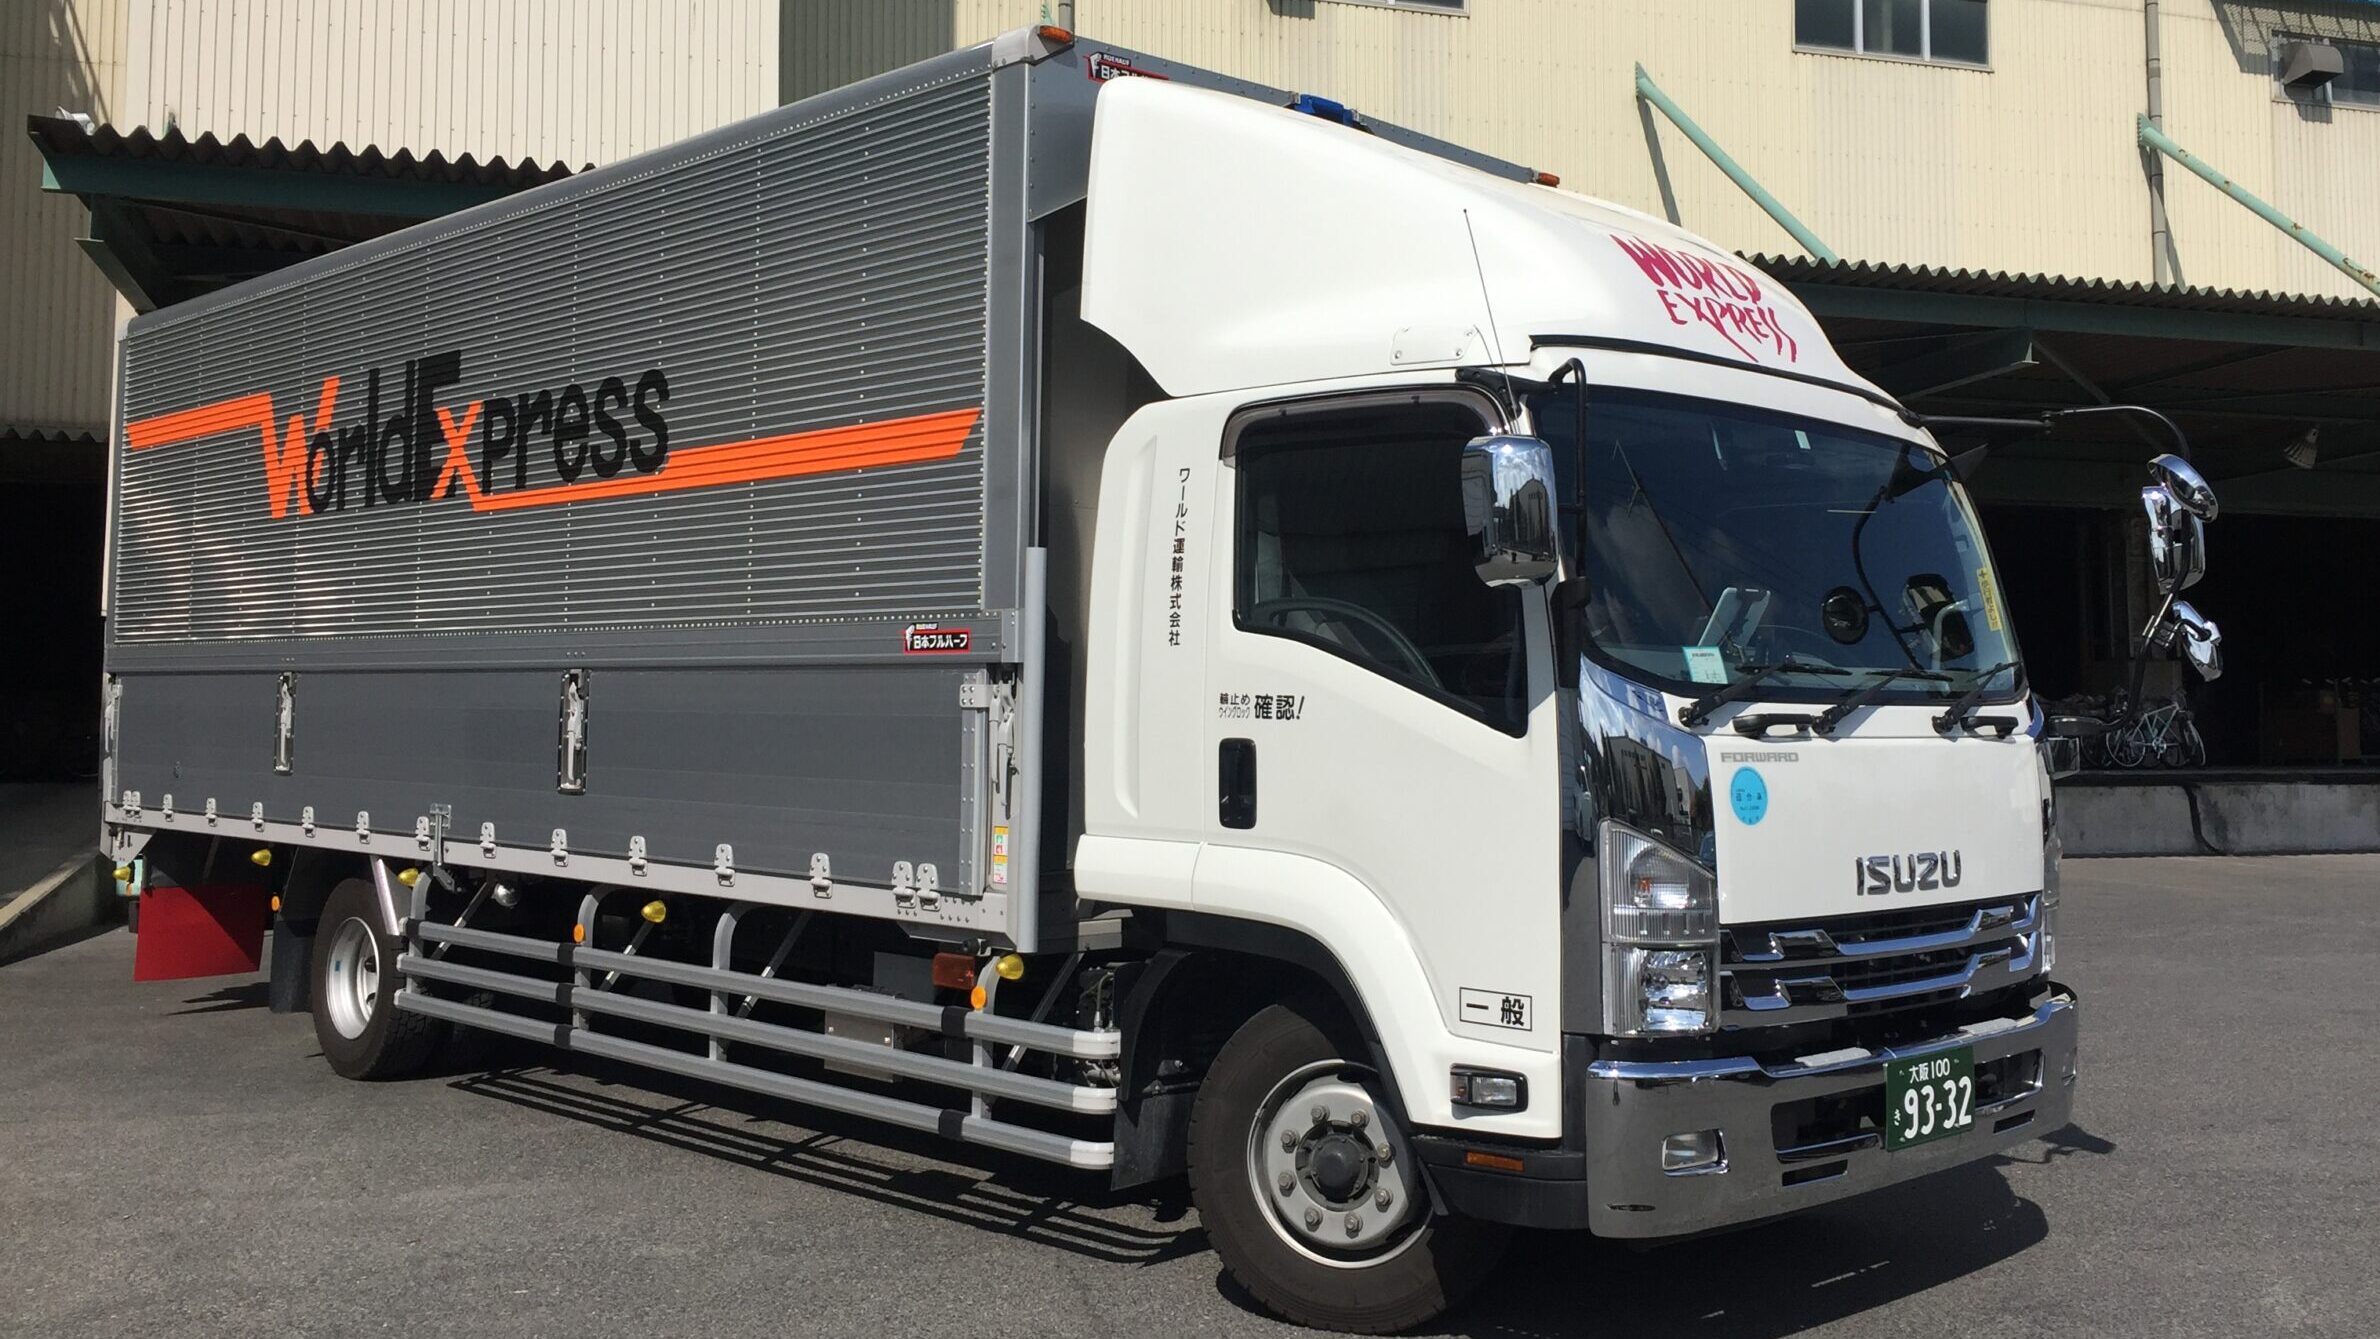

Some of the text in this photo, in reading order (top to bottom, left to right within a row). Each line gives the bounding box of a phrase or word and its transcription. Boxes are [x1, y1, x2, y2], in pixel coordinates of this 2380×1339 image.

[1610, 234, 1761, 304] WORLD
[1657, 289, 1797, 363] EXPRESS
[1168, 468, 1191, 647] ワールド運輸株式会社
[913, 634, 968, 649] 日本フルハーフ
[1720, 752, 1799, 762] FORWARD
[1856, 850, 1961, 896] ISUZU
[1466, 996, 1524, 1026] 一般
[1894, 1075, 1972, 1139] き 93-32
